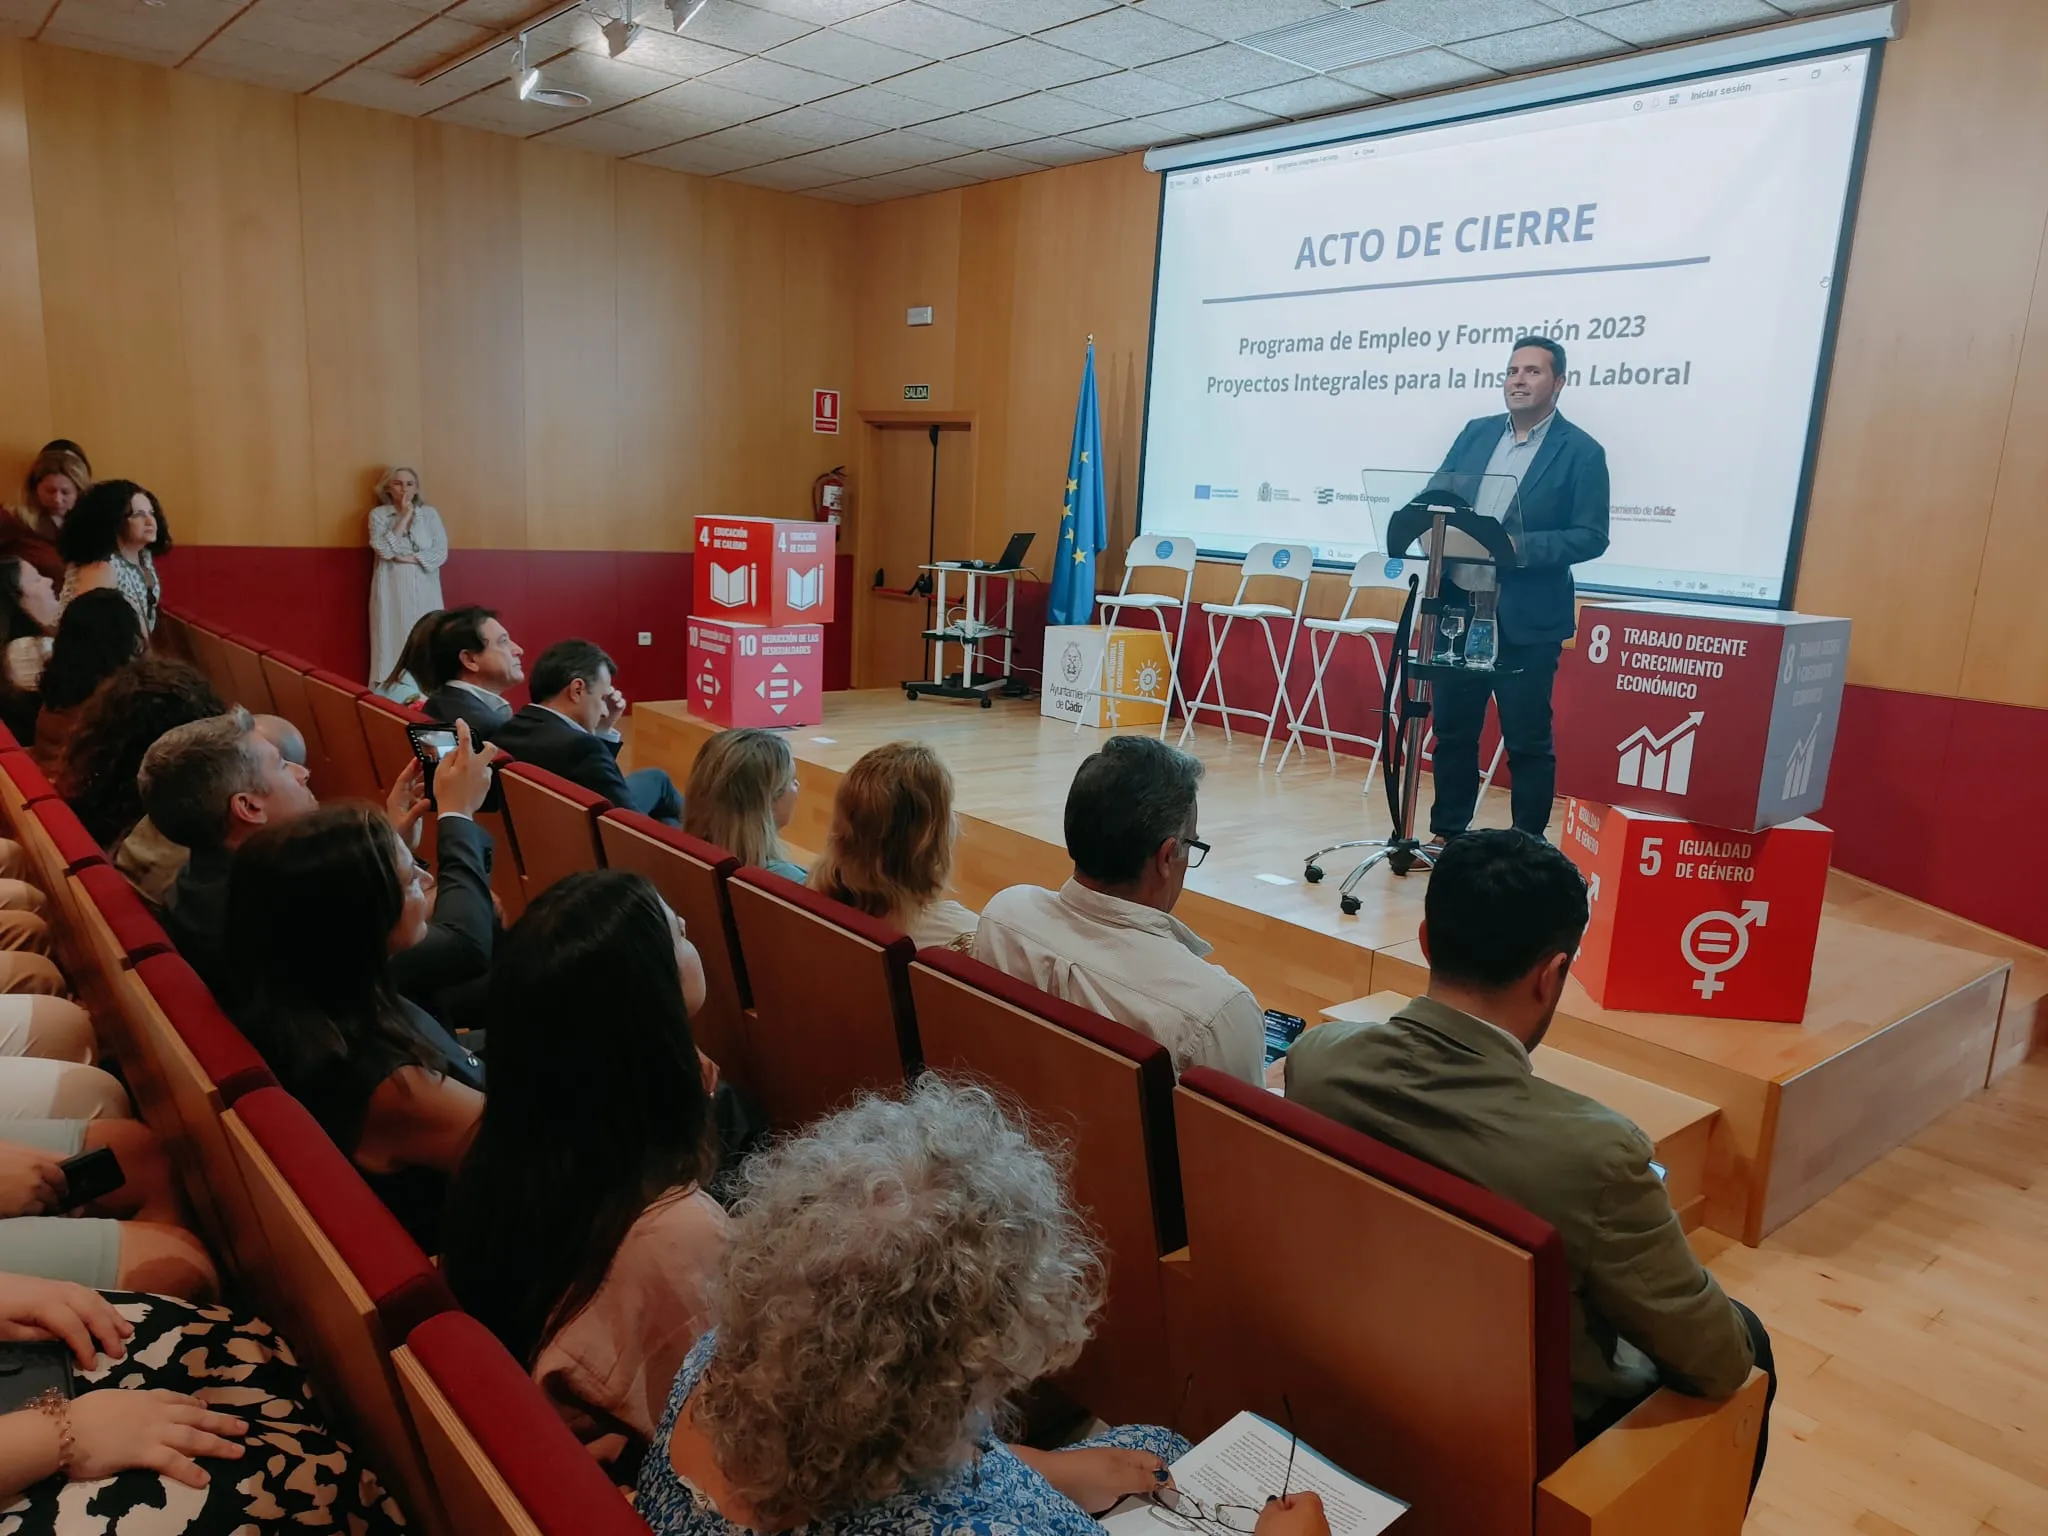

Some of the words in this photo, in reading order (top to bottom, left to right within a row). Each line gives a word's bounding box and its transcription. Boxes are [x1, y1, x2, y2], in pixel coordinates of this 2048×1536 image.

[1691, 87, 1718, 101] Iniciar
[1720, 82, 1751, 96] sesión
[1295, 228, 1385, 270] ACTO
[1397, 221, 1443, 259] DE
[1455, 203, 1597, 253] CIERRE
[1239, 335, 1324, 359] Programa
[1330, 331, 1352, 351] de
[1358, 327, 1431, 353] Empleo
[1437, 329, 1450, 352] y
[1456, 318, 1580, 345] Formación
[1587, 315, 1646, 340] 2023
[1207, 376, 1289, 398] Proyectos
[1294, 370, 1388, 396] Integrales
[1394, 372, 1440, 395] para
[1448, 368, 1466, 389] la
[1590, 361, 1691, 387] Laboral
[904, 387, 928, 399] SALIDA
[1336, 493, 1358, 502] Fondos
[1643, 506, 1652, 515] de
[1654, 505, 1676, 517] Cádiz
[700, 526, 710, 547] 4
[778, 532, 787, 552] 4
[689, 626, 699, 647] 10
[739, 635, 757, 656] 10
[1588, 625, 1611, 664] 8
[1624, 628, 1682, 649] TRABAJO
[1686, 635, 1748, 657] DECENTE
[1620, 651, 1630, 667] Y
[1632, 652, 1723, 679] CRECIMIENTO
[1784, 643, 1796, 684] 8
[1616, 674, 1697, 700] ECONÓMICO
[1056, 699, 1064, 710] de
[1567, 799, 1576, 834] 5
[1576, 826, 1582, 842] DE
[1639, 837, 1663, 876] 5
[1678, 839, 1751, 859] IGUALDAD
[1675, 862, 1692, 879] DE
[1698, 860, 1754, 883] GÉNERO
